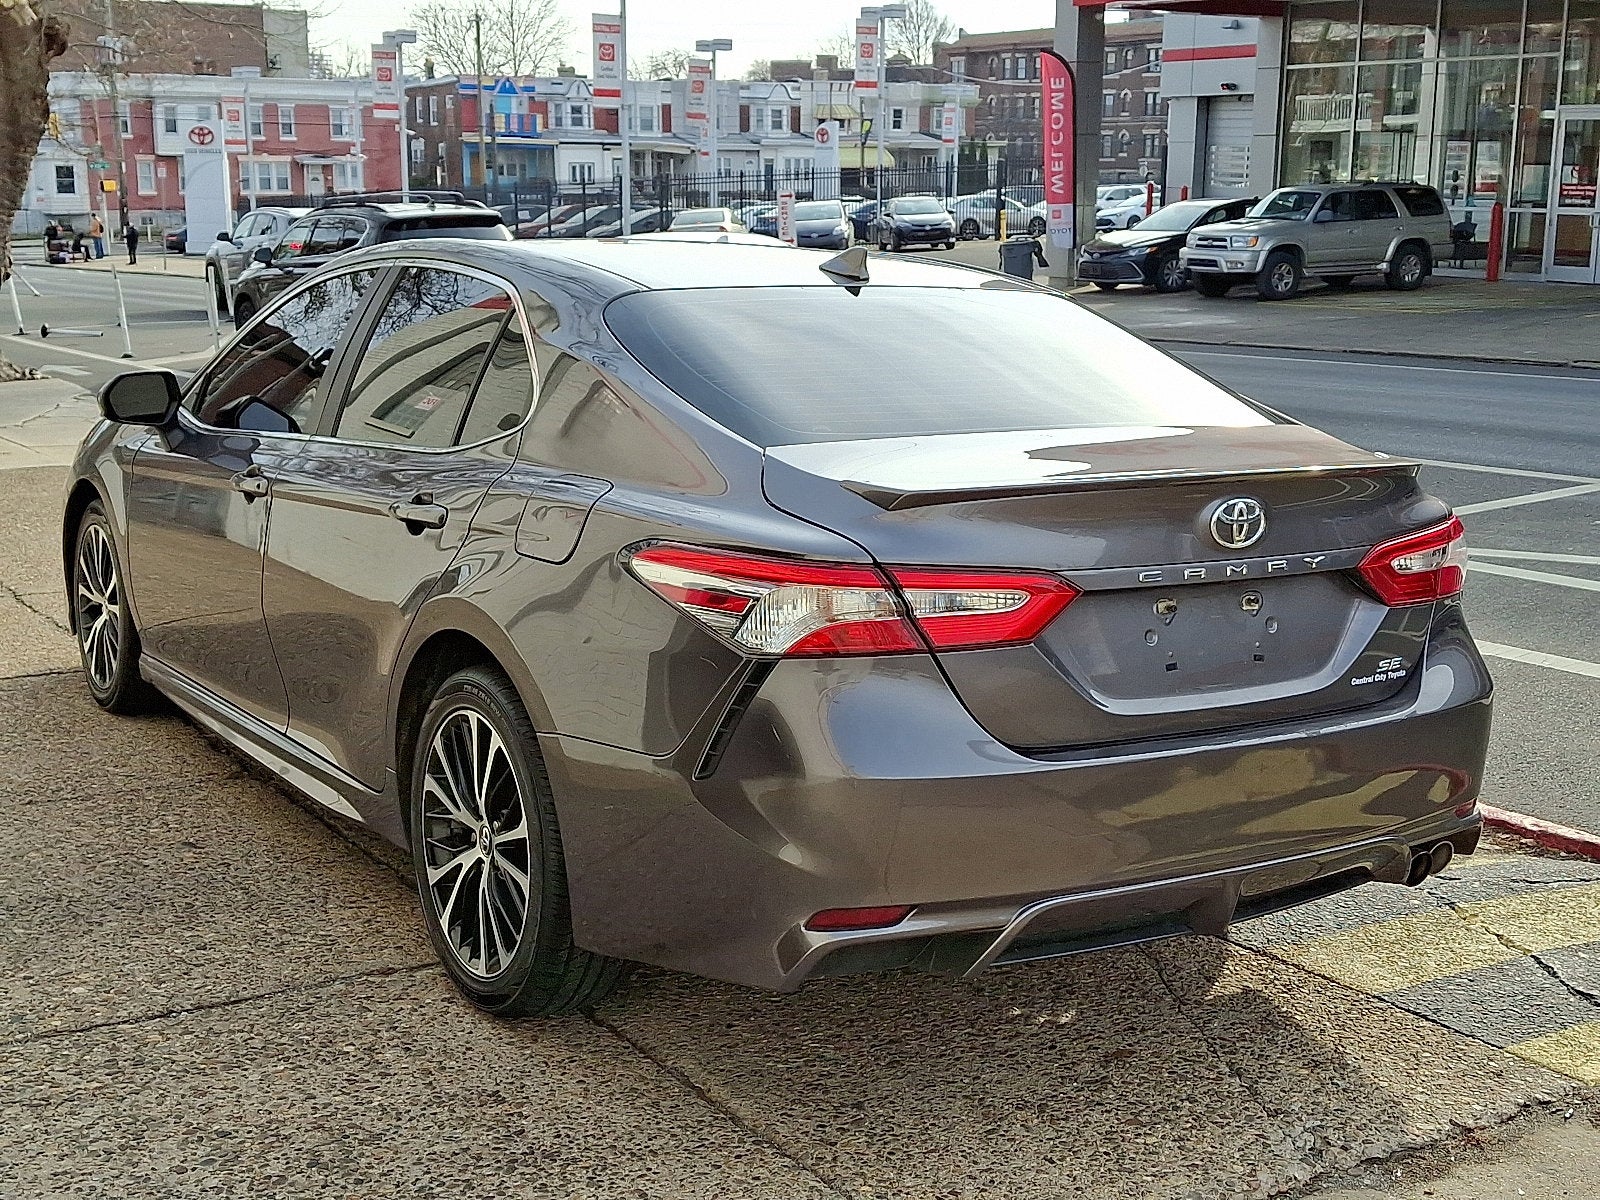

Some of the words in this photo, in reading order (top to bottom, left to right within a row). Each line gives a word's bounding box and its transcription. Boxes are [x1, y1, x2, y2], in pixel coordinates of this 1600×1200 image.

[781, 201, 789, 236] SERVICE
[1138, 555, 1326, 583] CAMRY
[1376, 656, 1403, 673] SE
[1351, 675, 1374, 686] Central
[1374, 673, 1387, 682] City
[1387, 669, 1407, 680] Toyota
